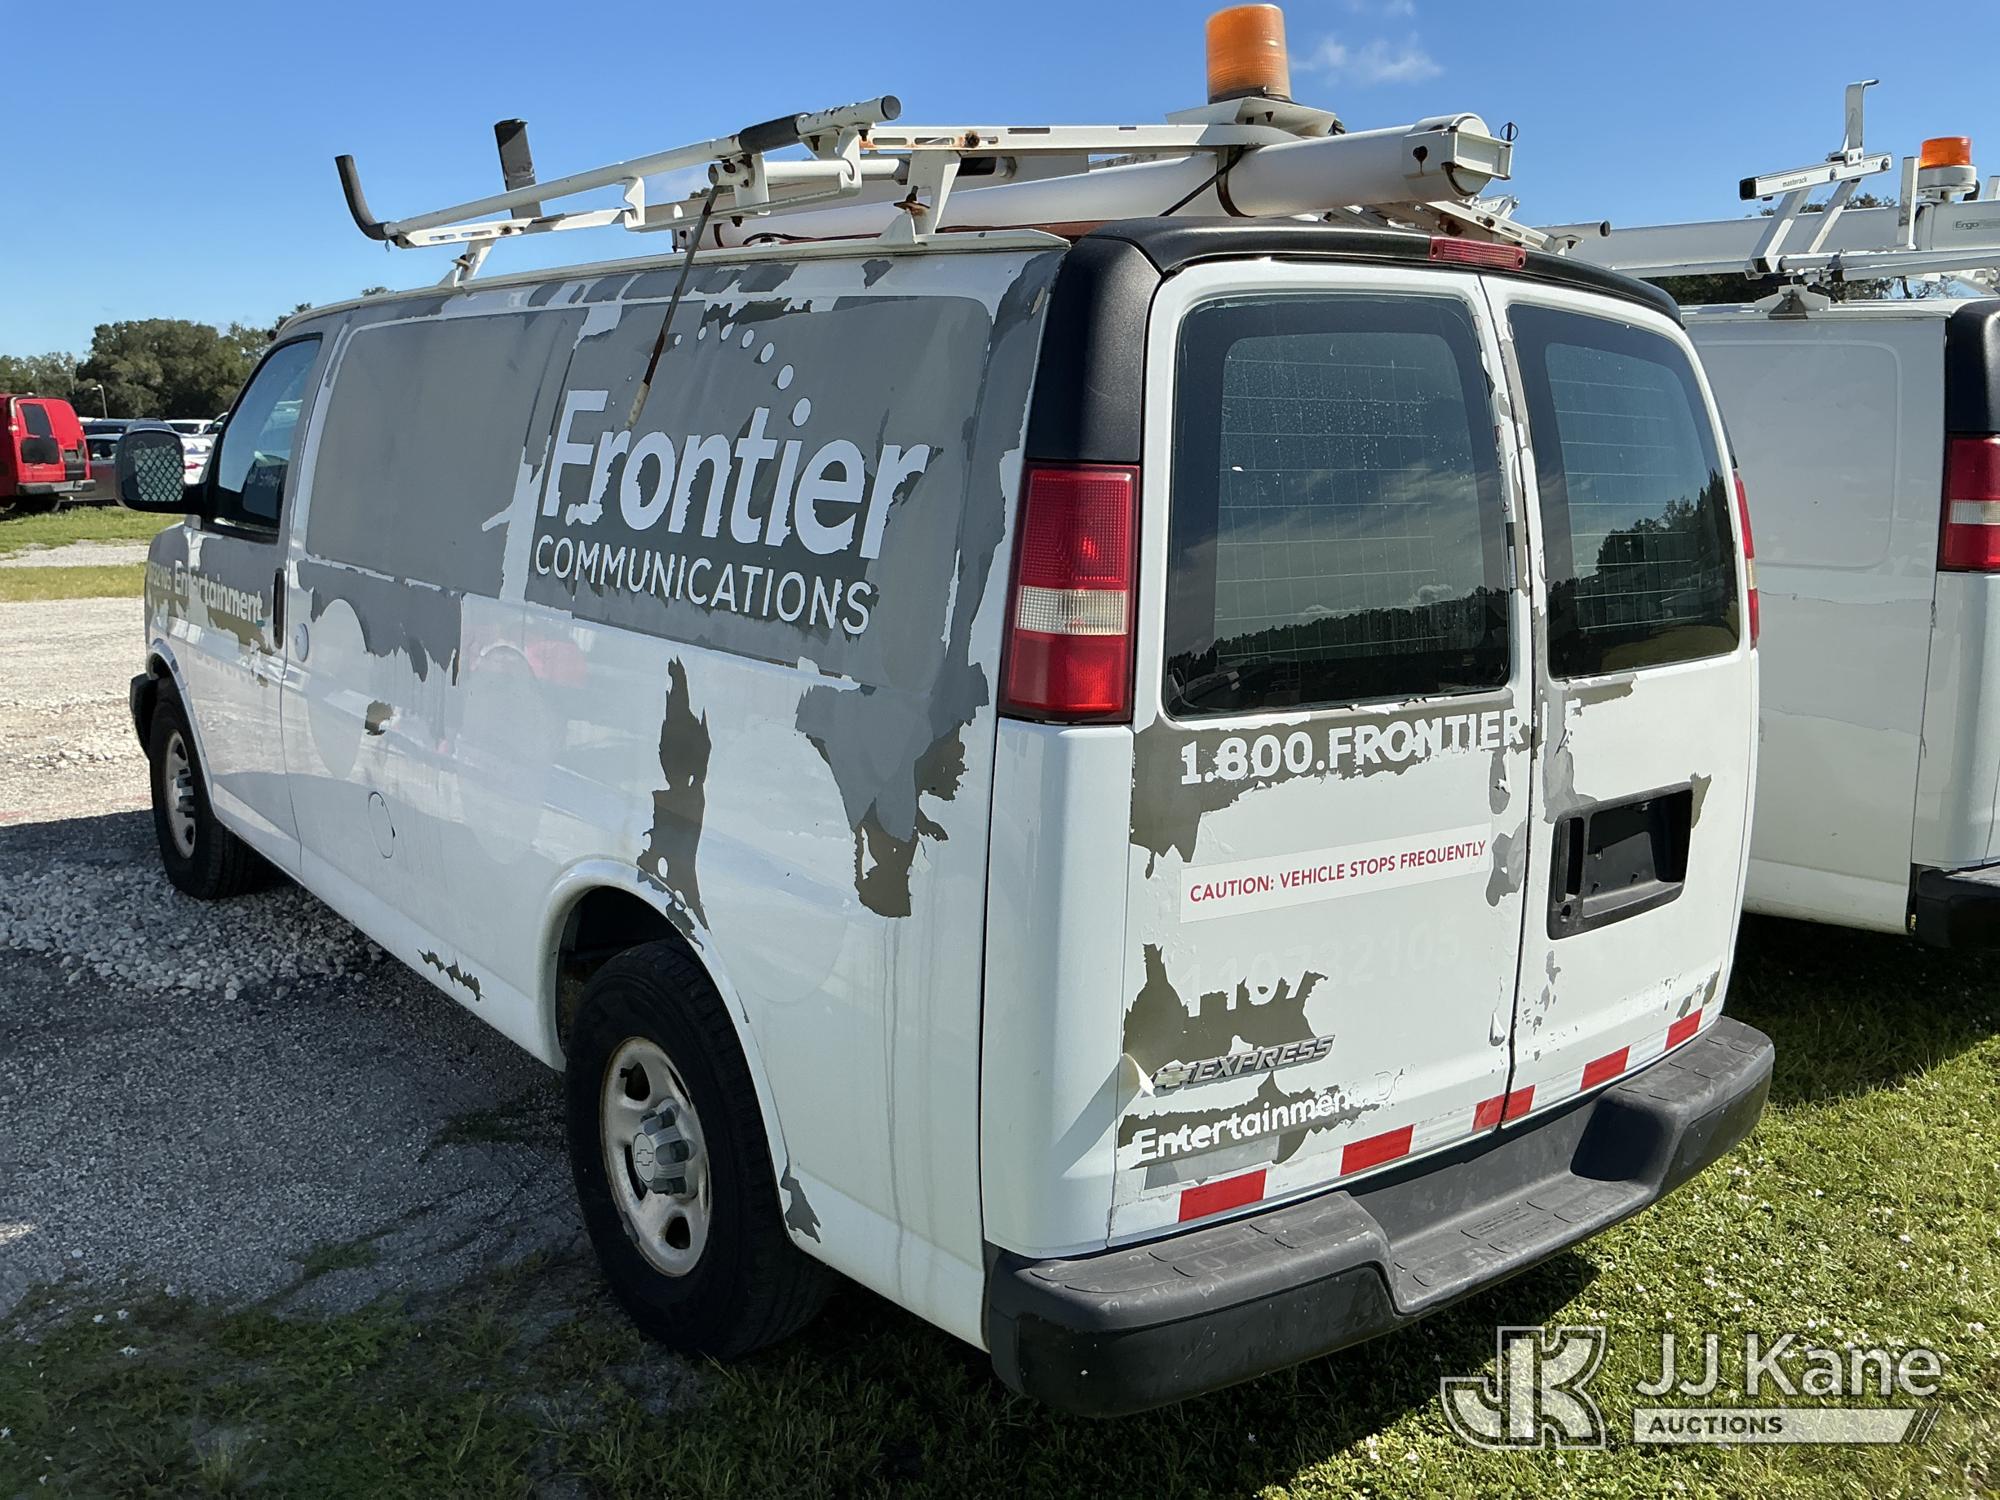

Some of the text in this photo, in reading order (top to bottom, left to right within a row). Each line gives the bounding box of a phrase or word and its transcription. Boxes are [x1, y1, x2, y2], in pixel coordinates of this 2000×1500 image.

[542, 390, 930, 560] Frontier
[535, 535, 872, 635] COMMUNICATIONS
[1181, 708, 1525, 785] 1.800.FRONTIER
[1189, 839, 1487, 903] CAUTION: VEHICLE STOPS FREQUENTLY
[1191, 1035, 1335, 1084] EXPRESS
